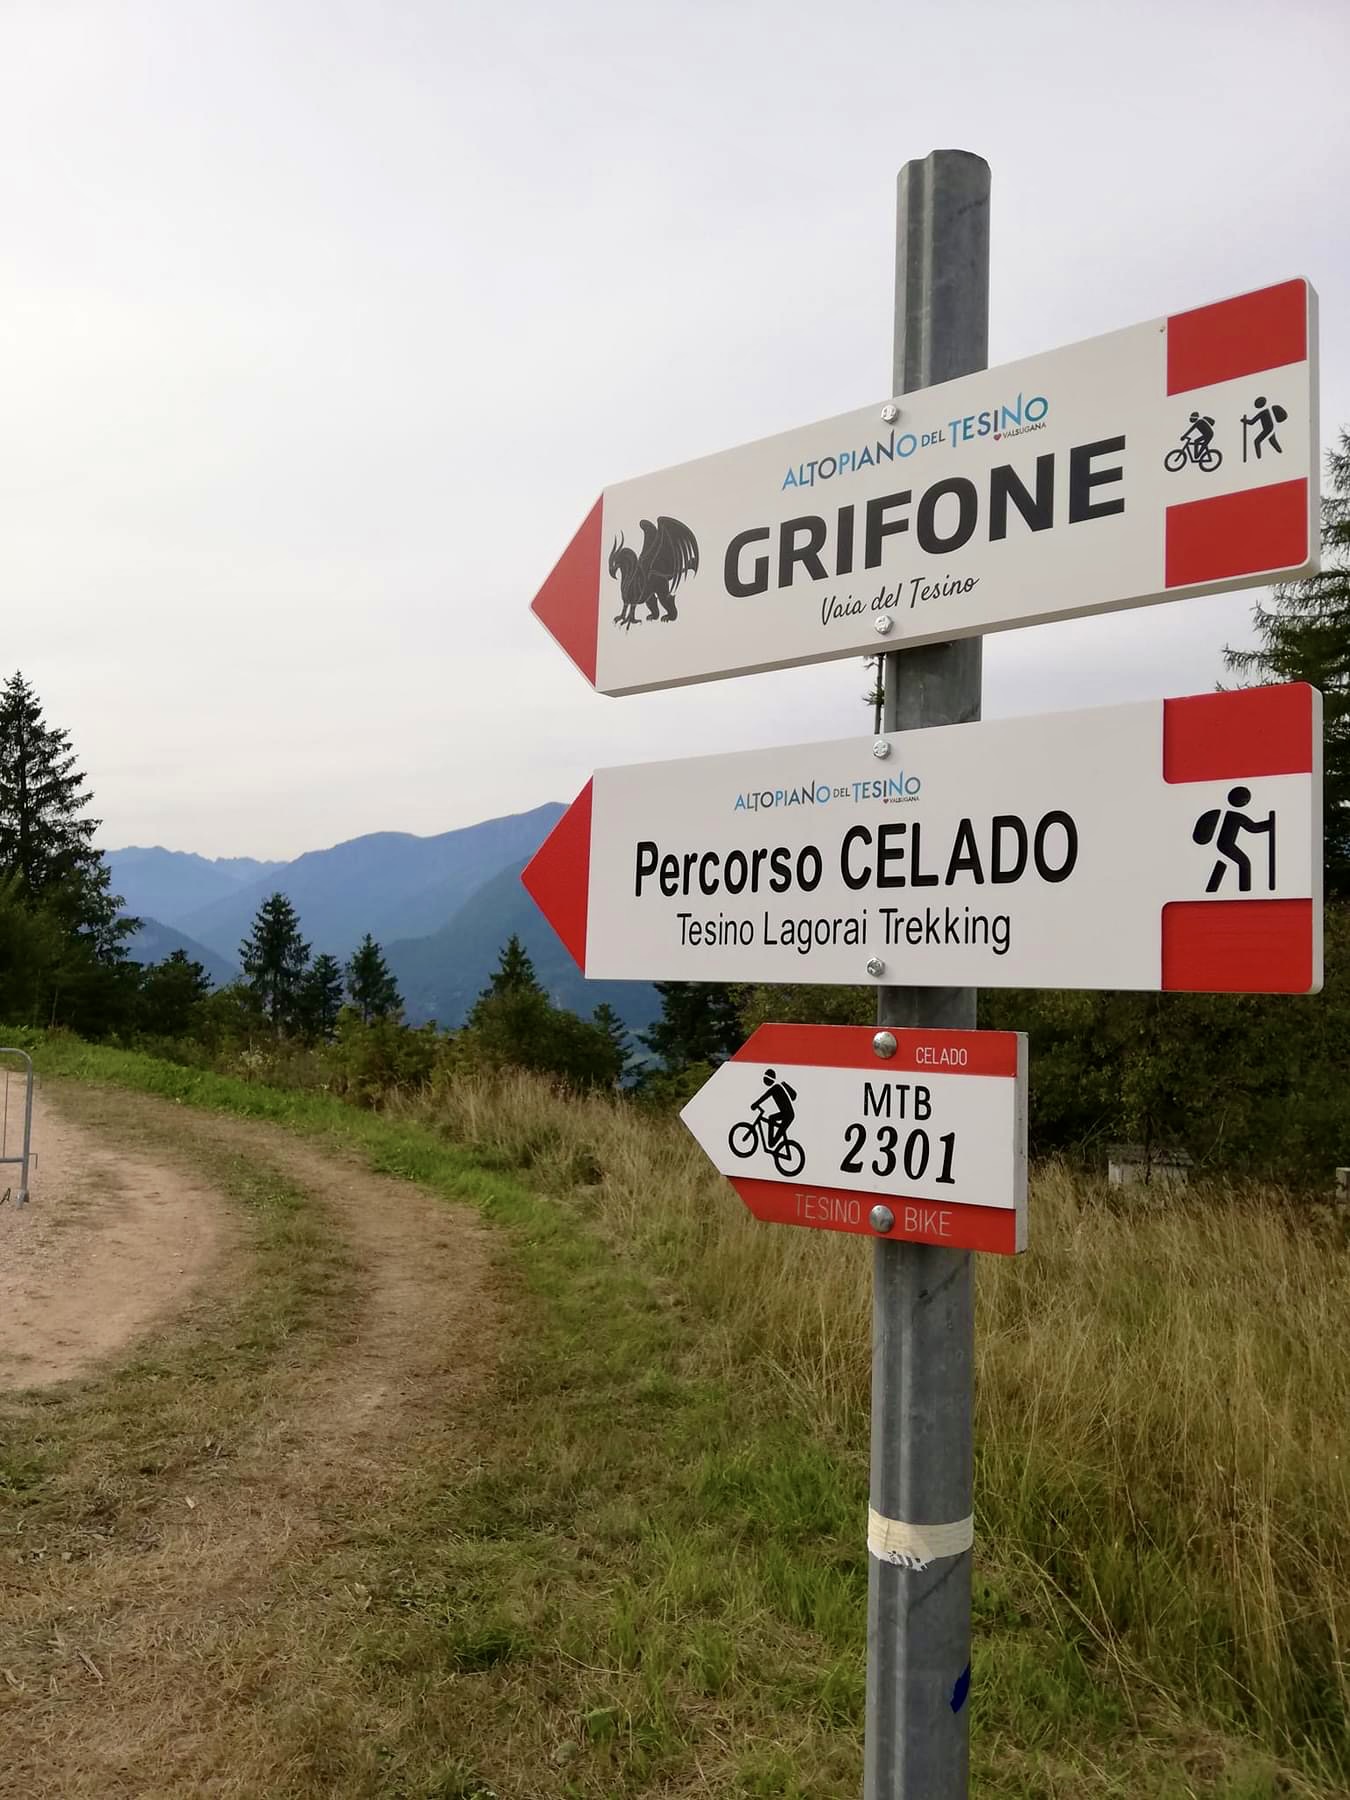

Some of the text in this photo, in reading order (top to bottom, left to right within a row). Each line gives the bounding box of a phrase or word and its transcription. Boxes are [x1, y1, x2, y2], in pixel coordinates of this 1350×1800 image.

[782, 393, 1048, 490] ALTOPIANO DEL TESINO
[1003, 422, 1046, 439] VALSUGANA
[724, 434, 1126, 597] GRIFONE
[821, 572, 980, 624] Vaia del Tesino
[734, 771, 921, 811] ALTOPIANO DEL TESINO
[635, 810, 1078, 897] Percorso CELADO
[676, 906, 1012, 955] Tesino Lagorai Trekking
[915, 1047, 968, 1066] CELADO
[863, 1082, 932, 1121] MTB
[840, 1123, 956, 1184] 2301
[794, 1193, 952, 1237] TESINO BIKE
